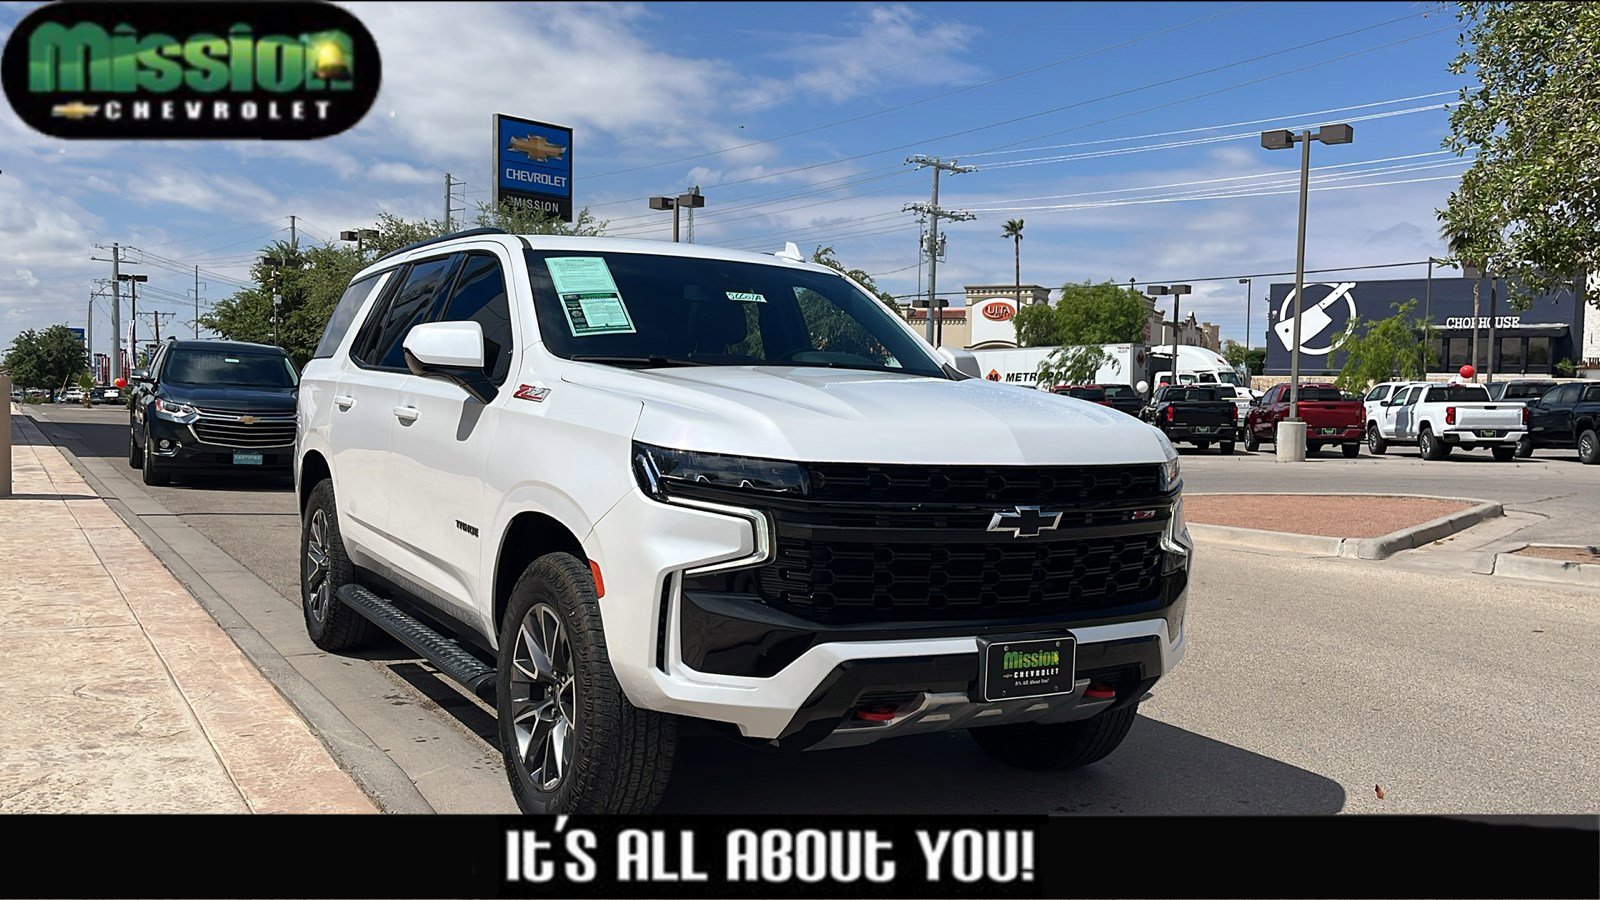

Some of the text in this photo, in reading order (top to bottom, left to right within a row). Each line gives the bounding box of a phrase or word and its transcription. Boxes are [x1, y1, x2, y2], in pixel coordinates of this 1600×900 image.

[506, 168, 567, 188] CHEVROLET
[987, 305, 1010, 314] ULTA
[513, 384, 551, 403] Z71
[1004, 650, 1059, 669] Mission
[1014, 668, 1059, 678] CHEVROLET
